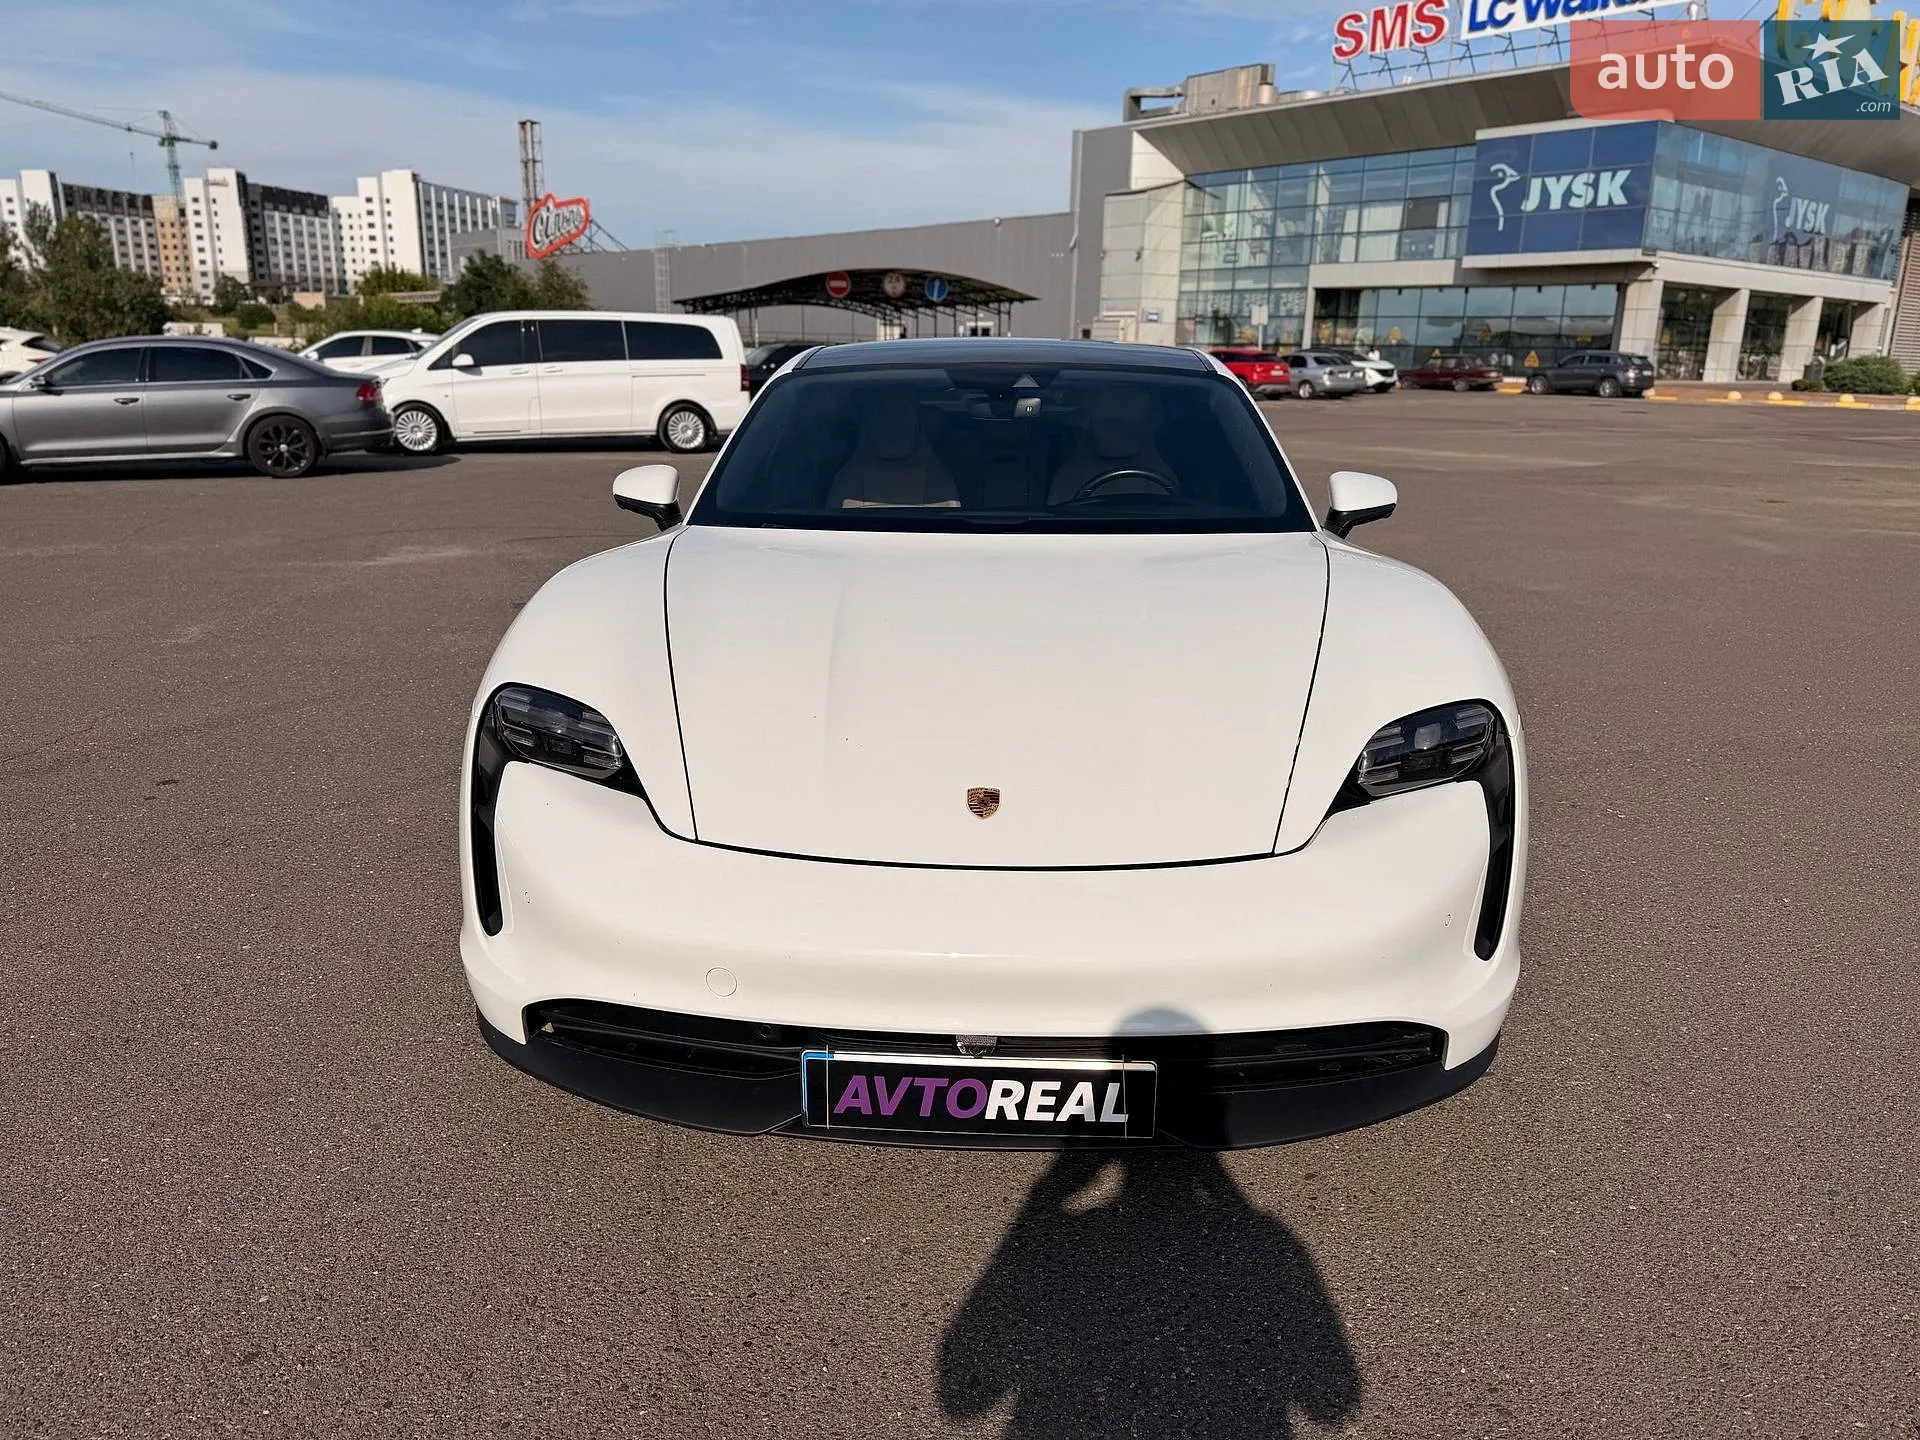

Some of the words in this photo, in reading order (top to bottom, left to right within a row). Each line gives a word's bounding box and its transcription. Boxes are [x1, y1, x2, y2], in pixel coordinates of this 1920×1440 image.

[1332, 0, 1449, 59] SMS
[1520, 169, 1632, 212] JYSK
[1785, 197, 1830, 234] JYSK
[833, 1074, 1129, 1123] AVTOREAL
